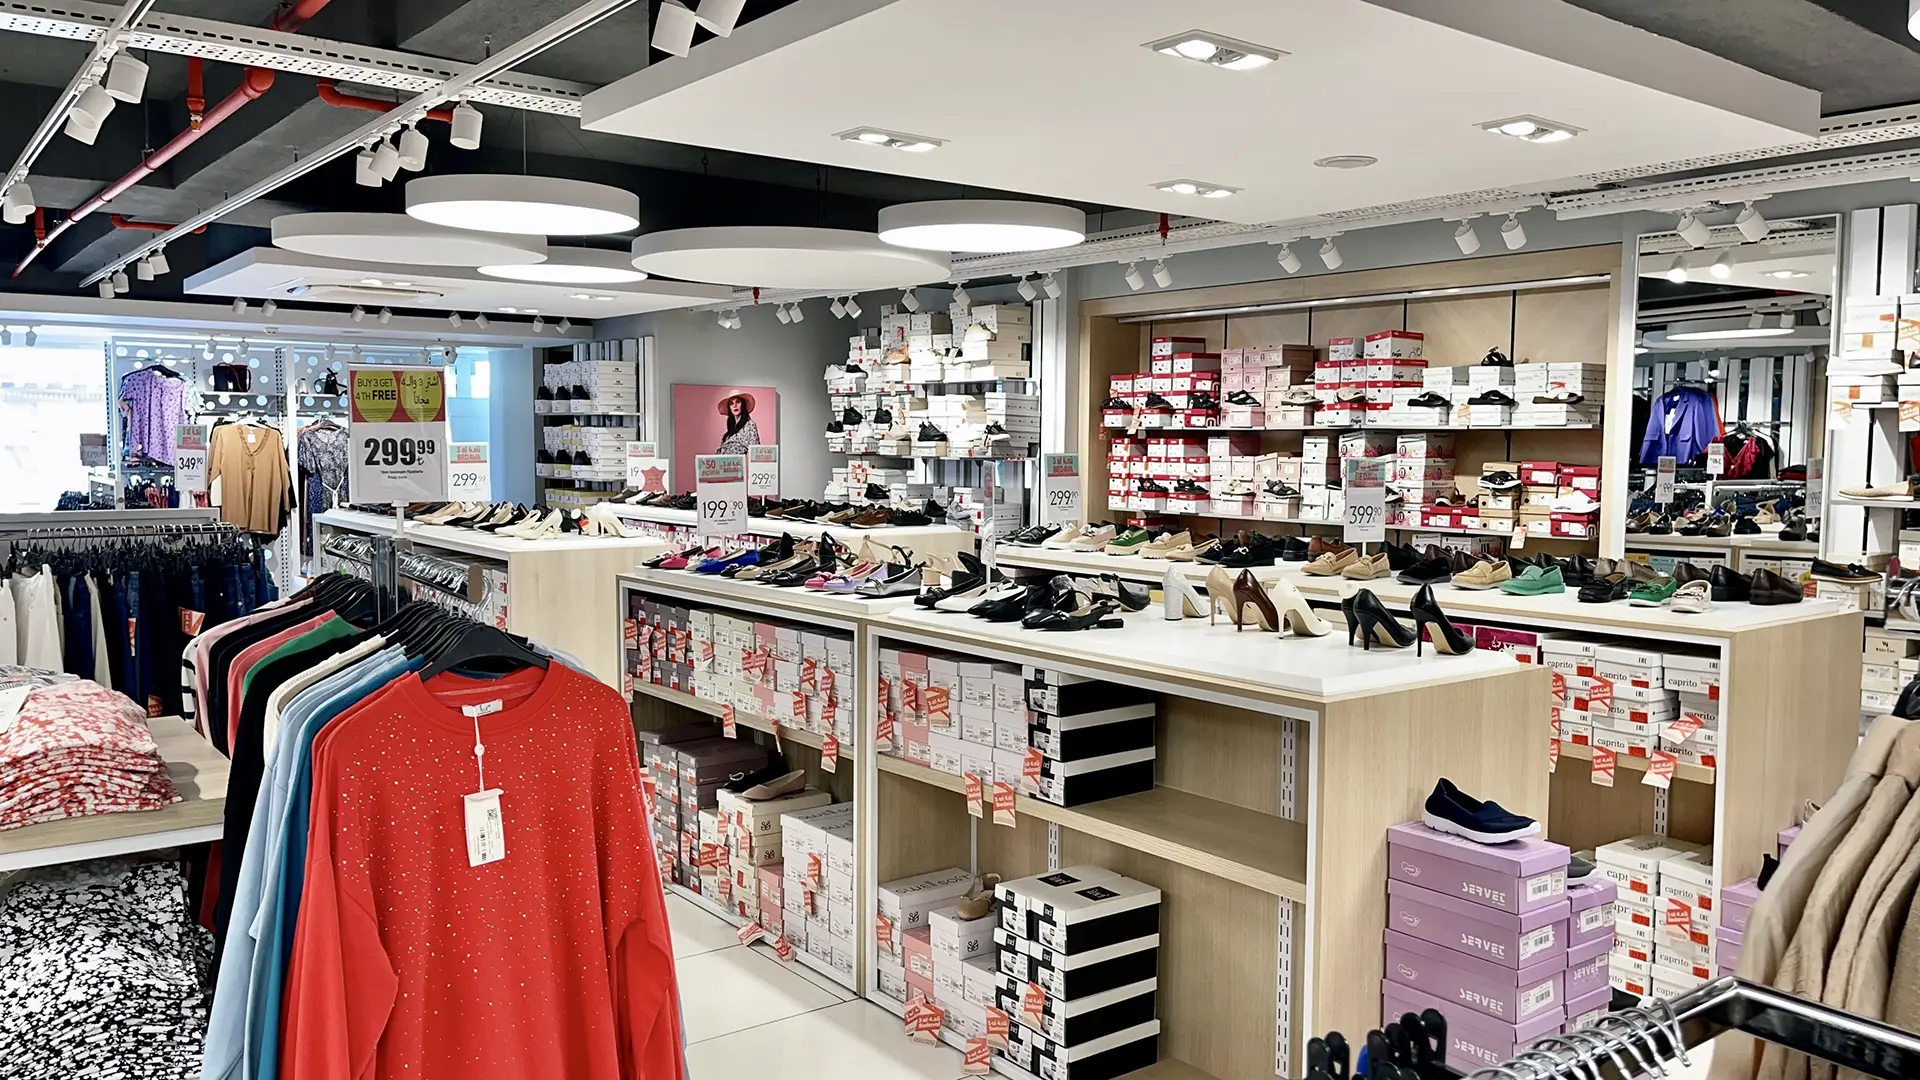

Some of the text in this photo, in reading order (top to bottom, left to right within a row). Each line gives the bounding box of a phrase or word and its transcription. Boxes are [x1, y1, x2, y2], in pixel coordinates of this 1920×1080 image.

[358, 378, 394, 387] BUY 3 GET
[356, 390, 396, 400] 4 TH FREE
[364, 438, 416, 466] 299
[417, 440, 435, 454] 99
[179, 457, 196, 470] 349
[453, 473, 477, 486] 299
[752, 473, 769, 484] 299
[1050, 490, 1071, 505] 299
[703, 501, 743, 518] 199 90
[1349, 506, 1373, 524] 399
[1547, 660, 1573, 669] caprito
[1668, 677, 1698, 688] caprito
[1597, 738, 1624, 748] caprito
[1665, 885, 1693, 899] caprito
[1660, 953, 1689, 967] caprito
